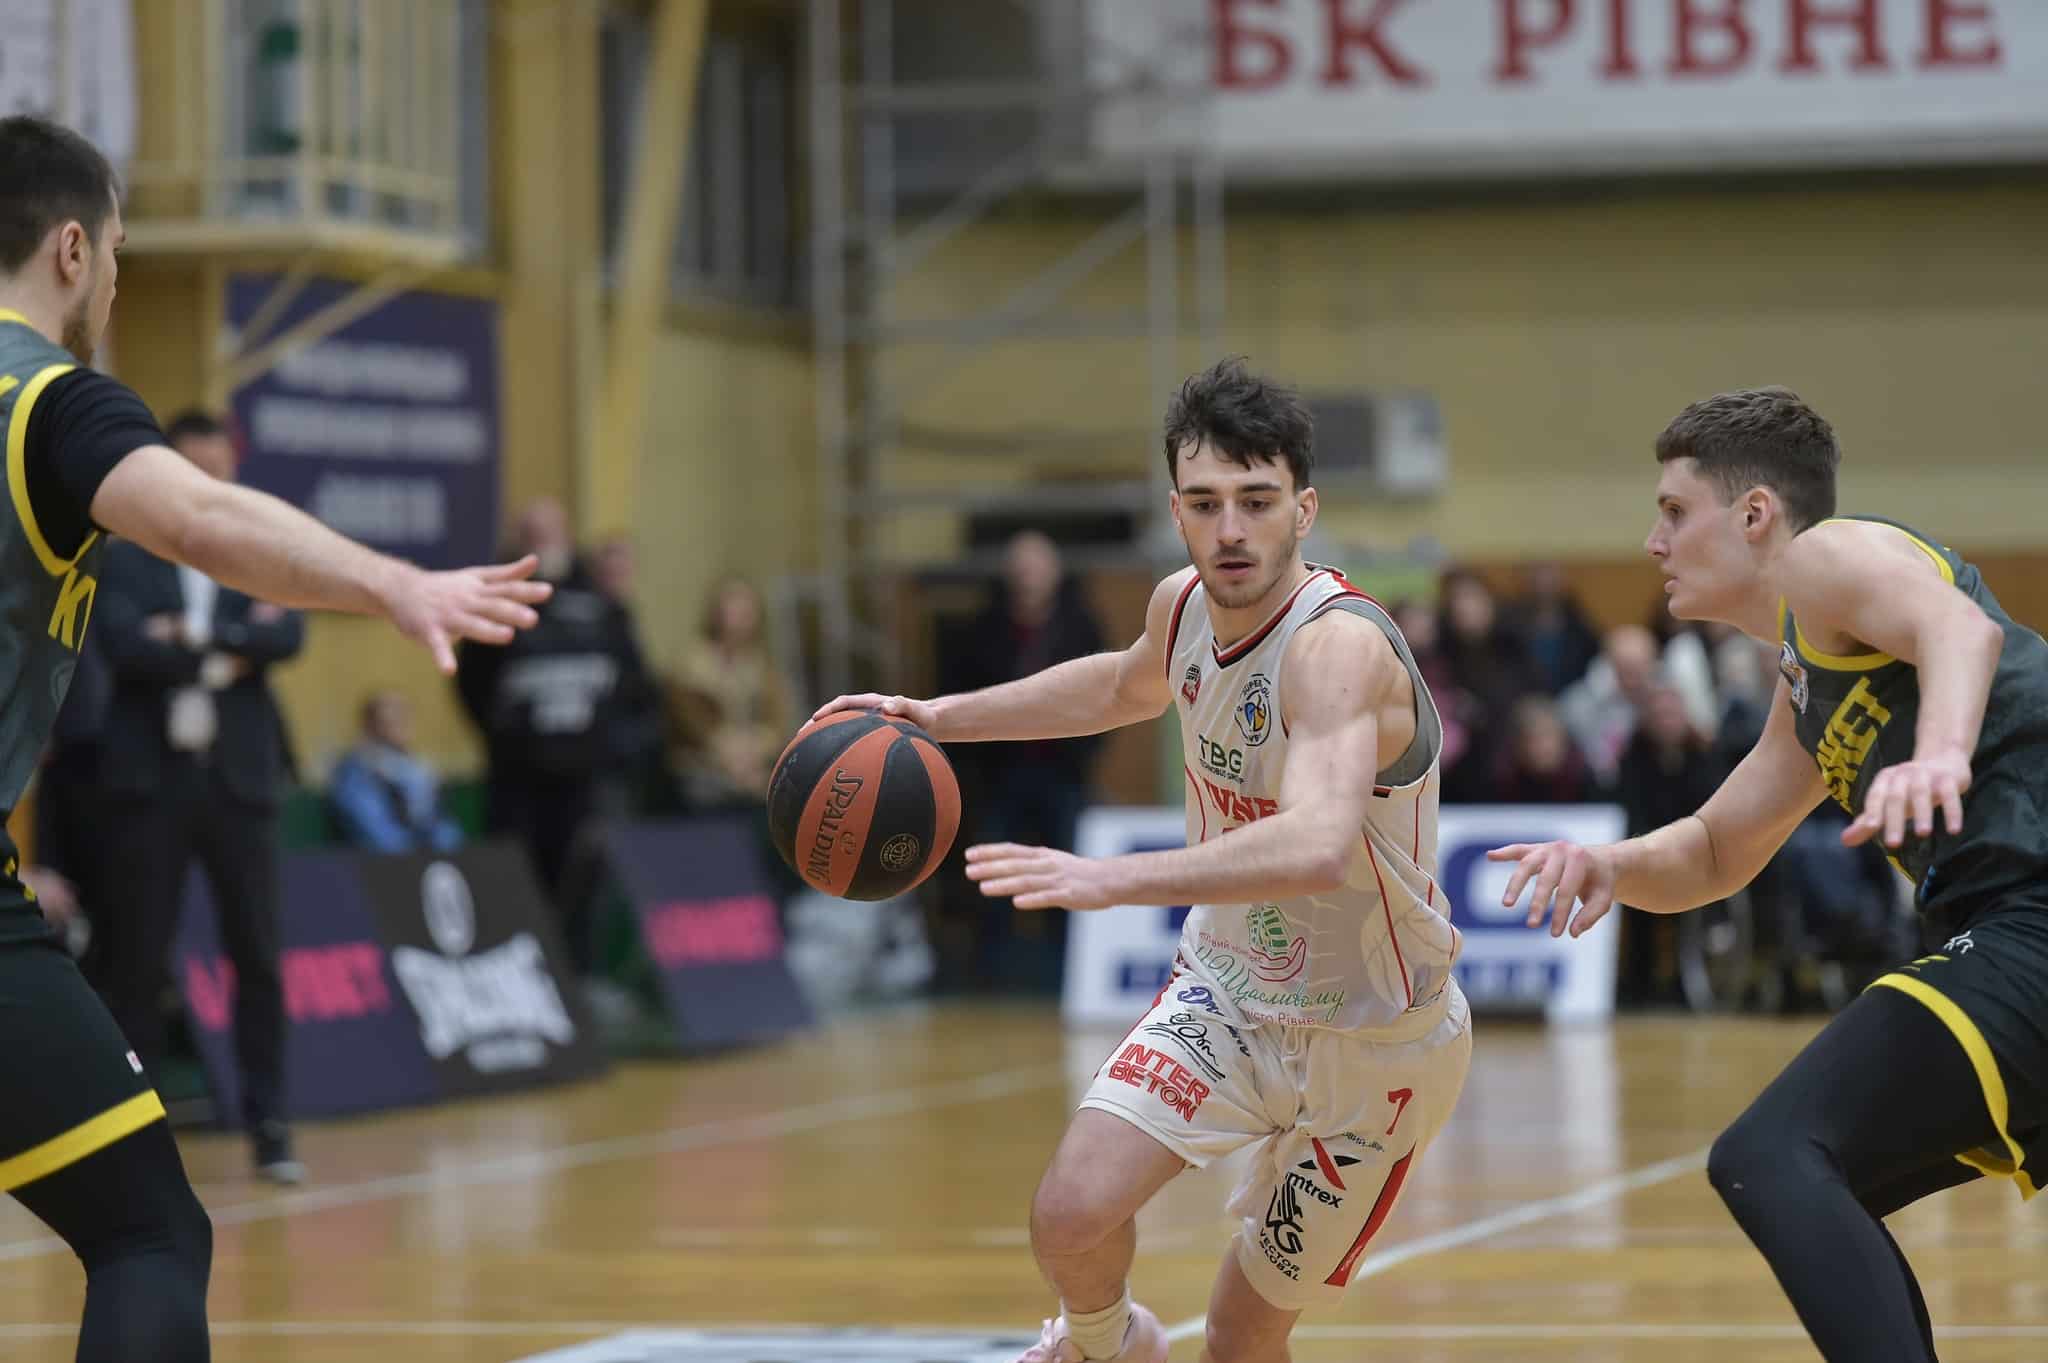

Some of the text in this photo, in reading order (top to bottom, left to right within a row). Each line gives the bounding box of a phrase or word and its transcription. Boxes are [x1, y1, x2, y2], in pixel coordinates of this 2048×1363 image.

[1491, 0, 2006, 84] РІВНЕ
[1199, 733, 1243, 774] TBG
[806, 767, 864, 886] SPALDING
[1108, 1060, 1199, 1123] BETON
[1118, 1042, 1210, 1107] INTER
[1387, 1087, 1414, 1136] 7
[1285, 1171, 1345, 1209] mtrex
[1259, 1227, 1301, 1273] VECTOR
